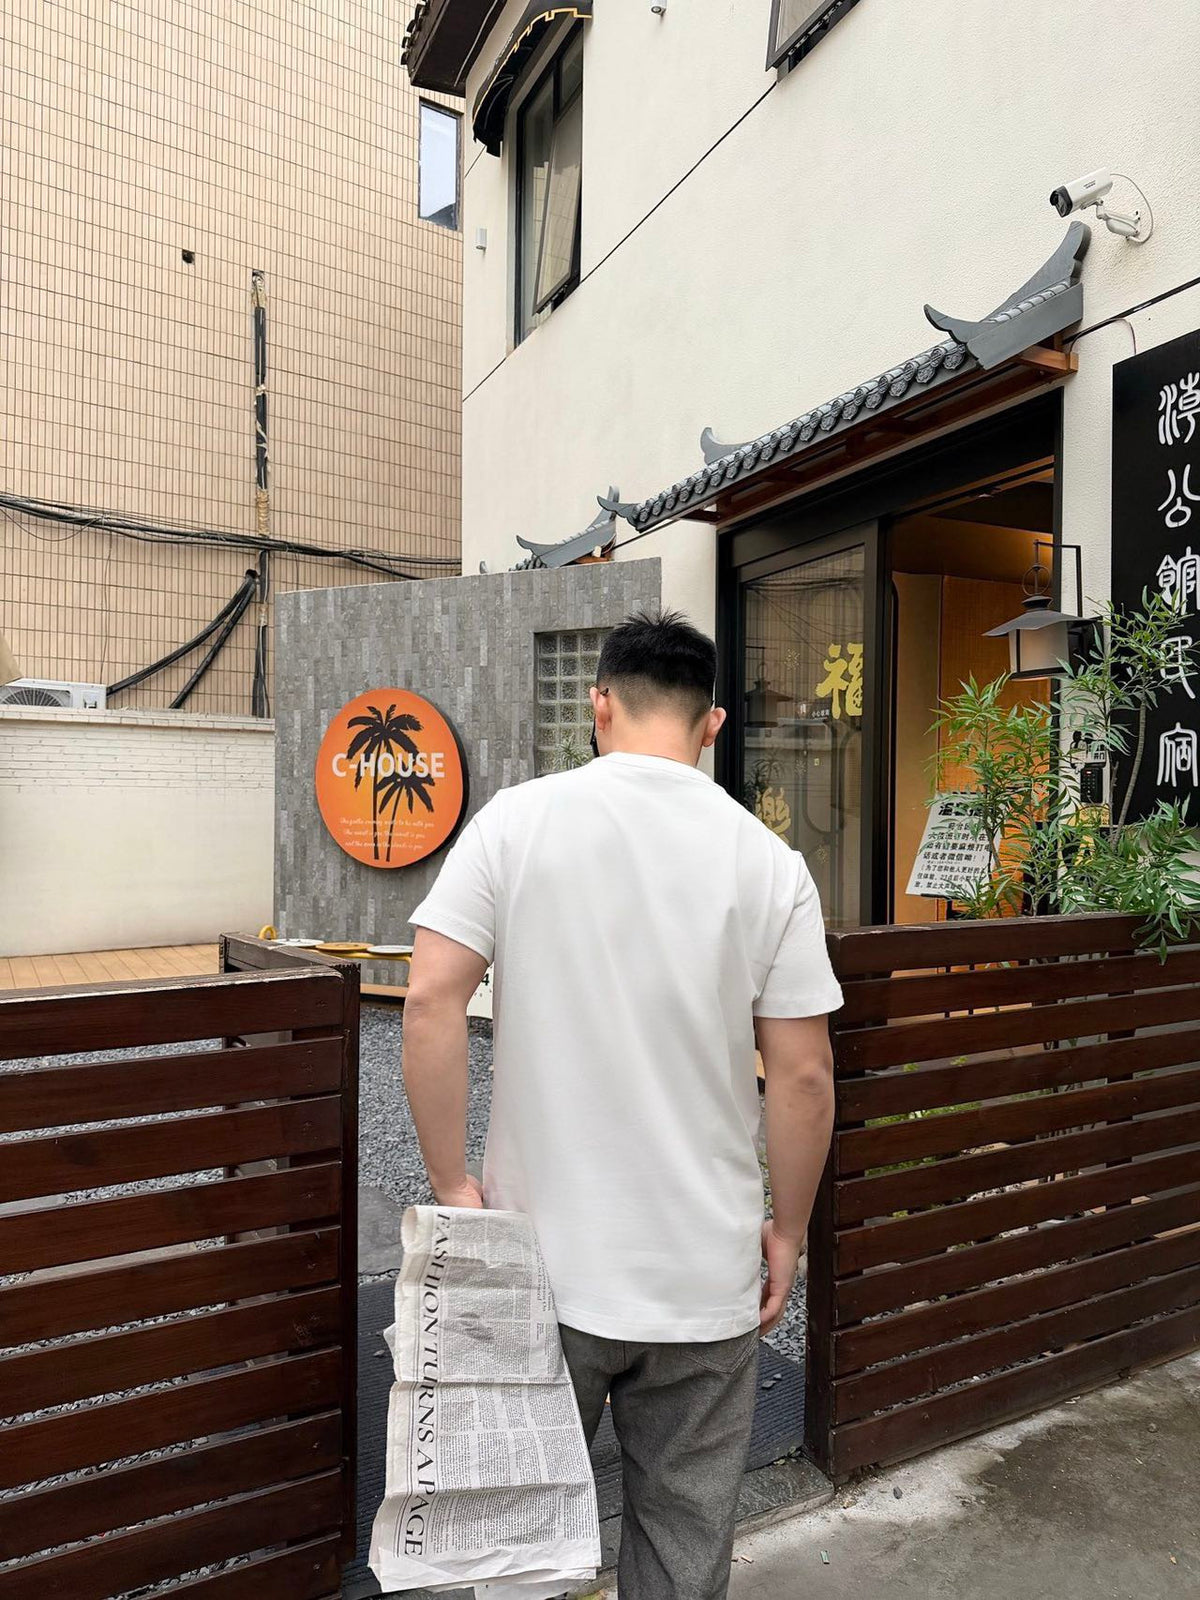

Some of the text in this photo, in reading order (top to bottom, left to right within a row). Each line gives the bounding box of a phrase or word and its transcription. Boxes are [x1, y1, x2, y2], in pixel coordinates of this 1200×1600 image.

[815, 642, 864, 720] 福
[332, 752, 445, 779] C-HOUSE
[404, 1213, 451, 1556] FASHION TURNS A PAGE
